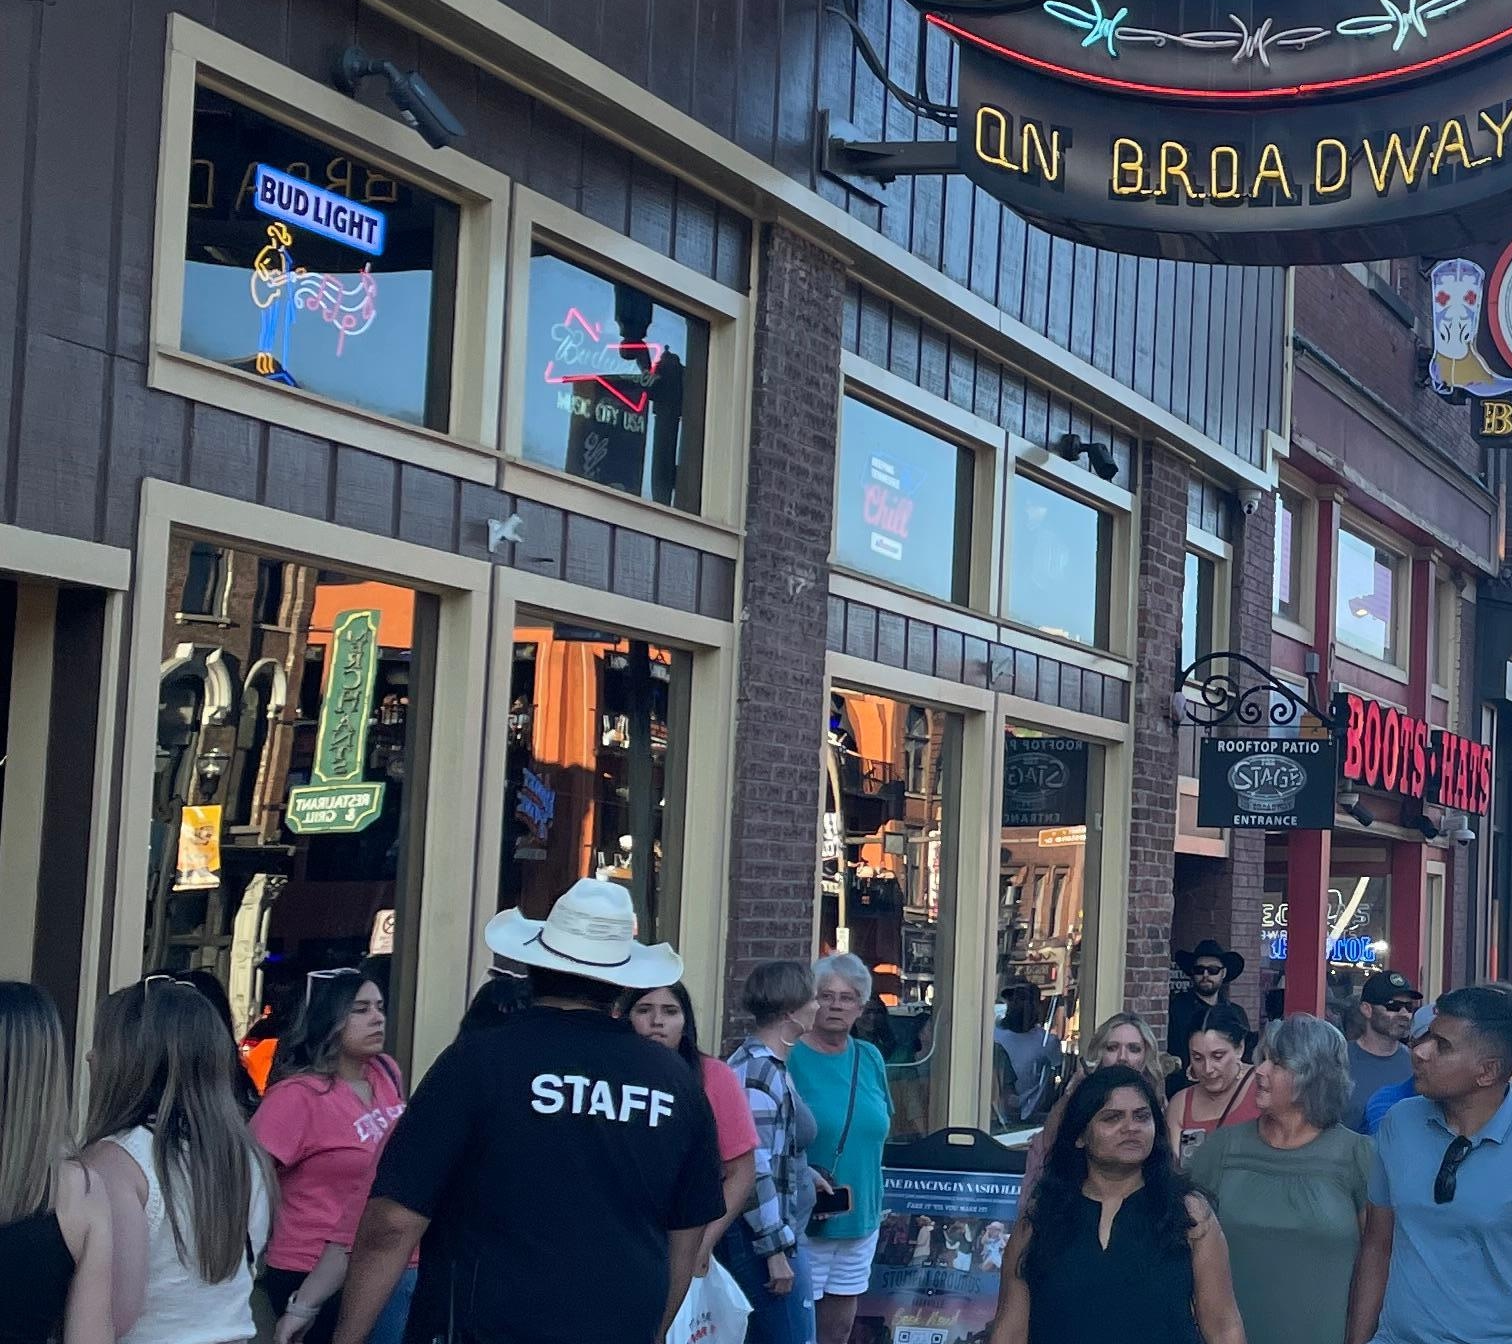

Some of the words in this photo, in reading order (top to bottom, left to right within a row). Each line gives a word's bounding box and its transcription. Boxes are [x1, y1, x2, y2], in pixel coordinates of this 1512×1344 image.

[974, 106, 1062, 183] ON
[260, 174, 309, 217] BUD
[313, 195, 378, 245] LIGHT
[557, 391, 592, 418] MUSIC
[595, 404, 619, 426] CITY
[623, 411, 644, 434] USA
[1217, 740, 1278, 752] ROOFTOP
[1282, 741, 1320, 753] PATIO
[1344, 694, 1427, 798] BOOTS
[1439, 731, 1491, 817] HATS
[1231, 761, 1301, 790] STAGE
[1233, 815, 1298, 826] ENTRANCE
[531, 1073, 675, 1127] STAFF
[884, 1178, 904, 1189] INE
[904, 1180, 951, 1191] DANCING
[953, 1182, 964, 1193] IN
